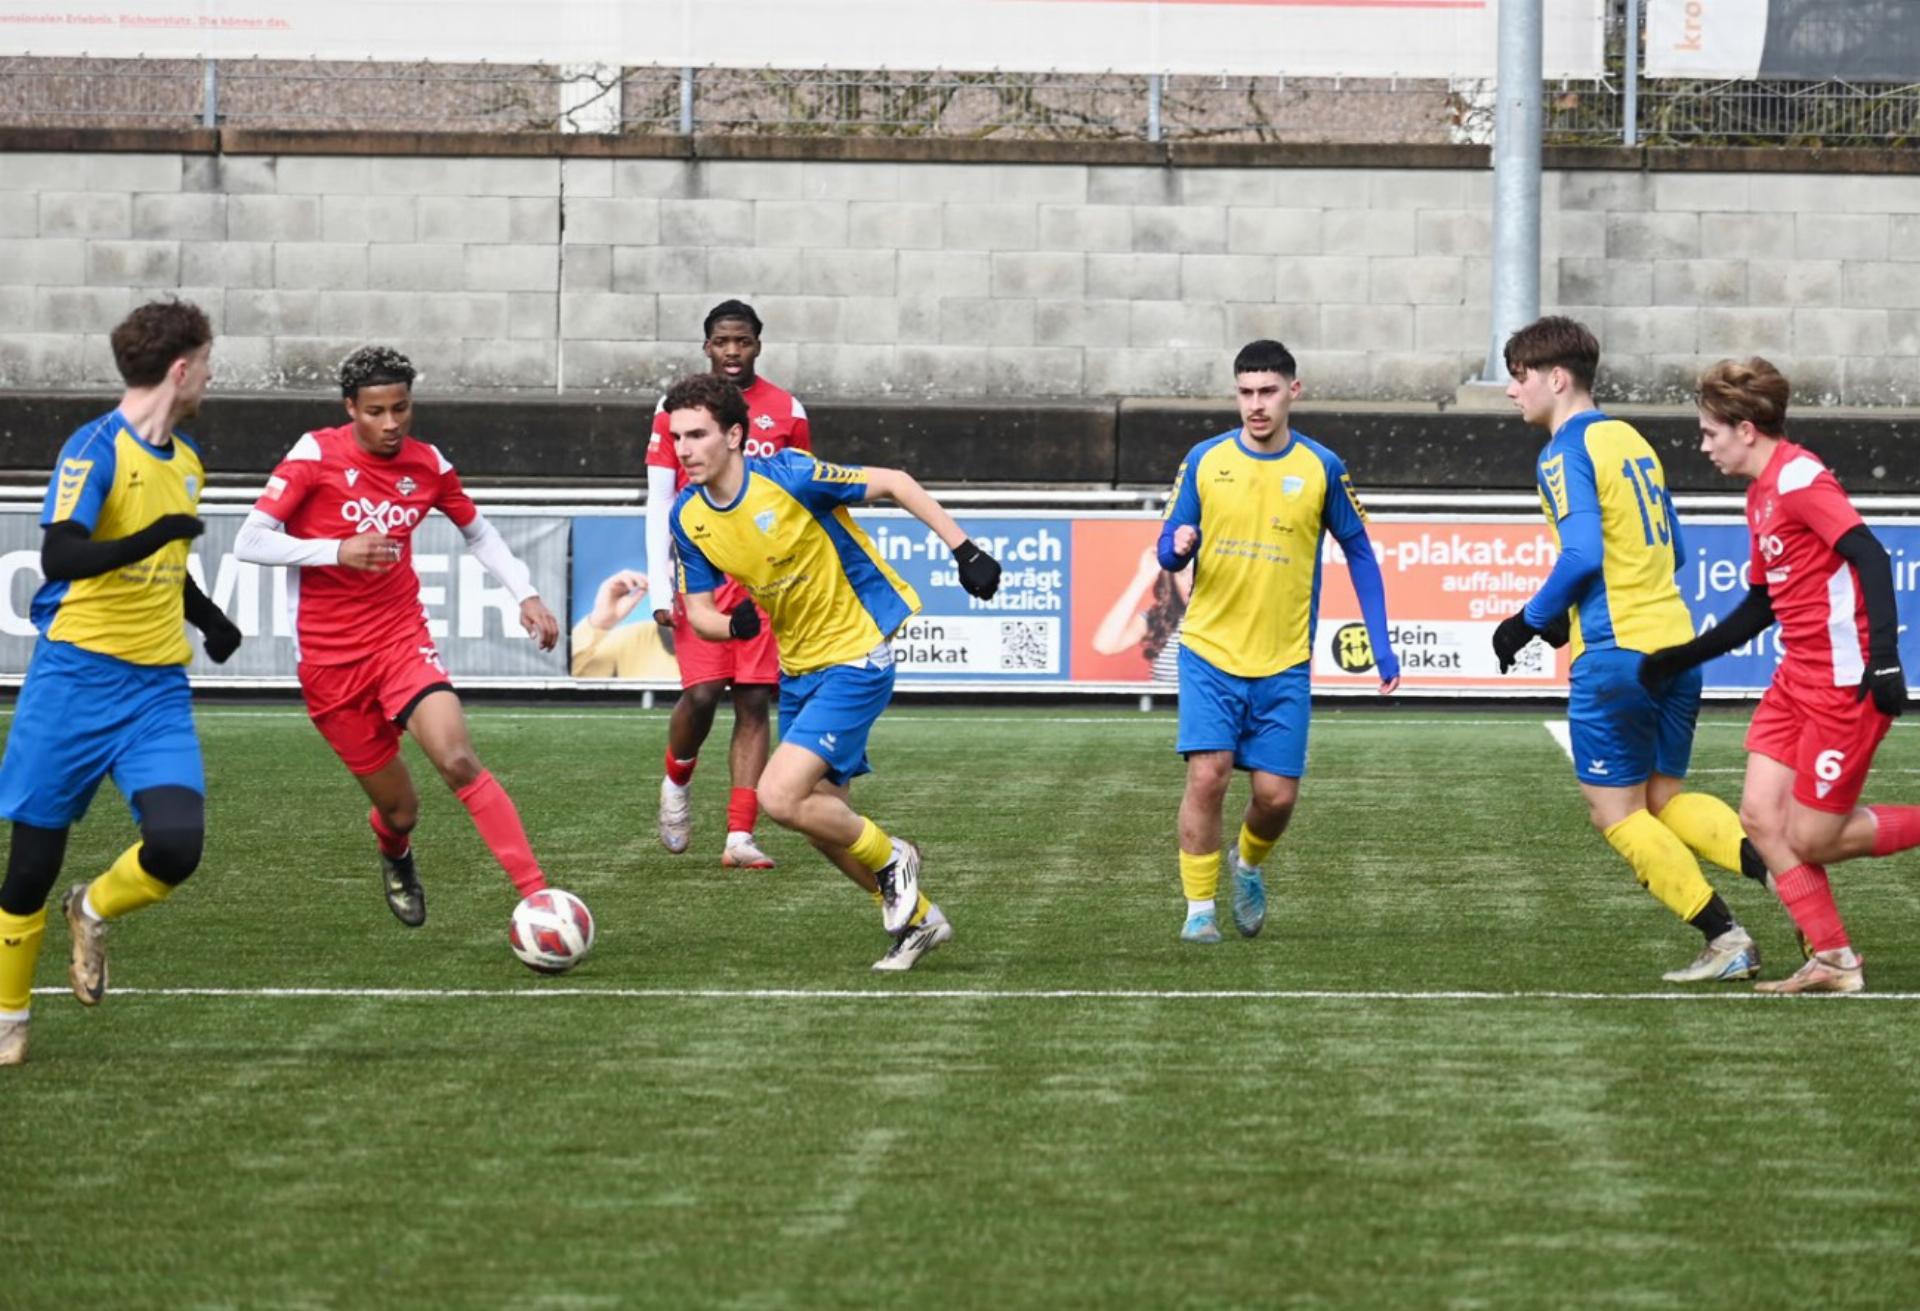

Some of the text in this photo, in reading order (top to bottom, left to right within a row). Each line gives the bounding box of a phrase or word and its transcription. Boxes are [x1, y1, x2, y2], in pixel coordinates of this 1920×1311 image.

[1622, 456, 1670, 546] 15
[930, 567, 1062, 592] auprägt
[1442, 571, 1545, 592] auffallen
[895, 620, 944, 640] dein
[1388, 625, 1437, 645] dein
[894, 644, 968, 663] plakat
[1402, 649, 1461, 668] lakat
[1815, 749, 1846, 781] 6
